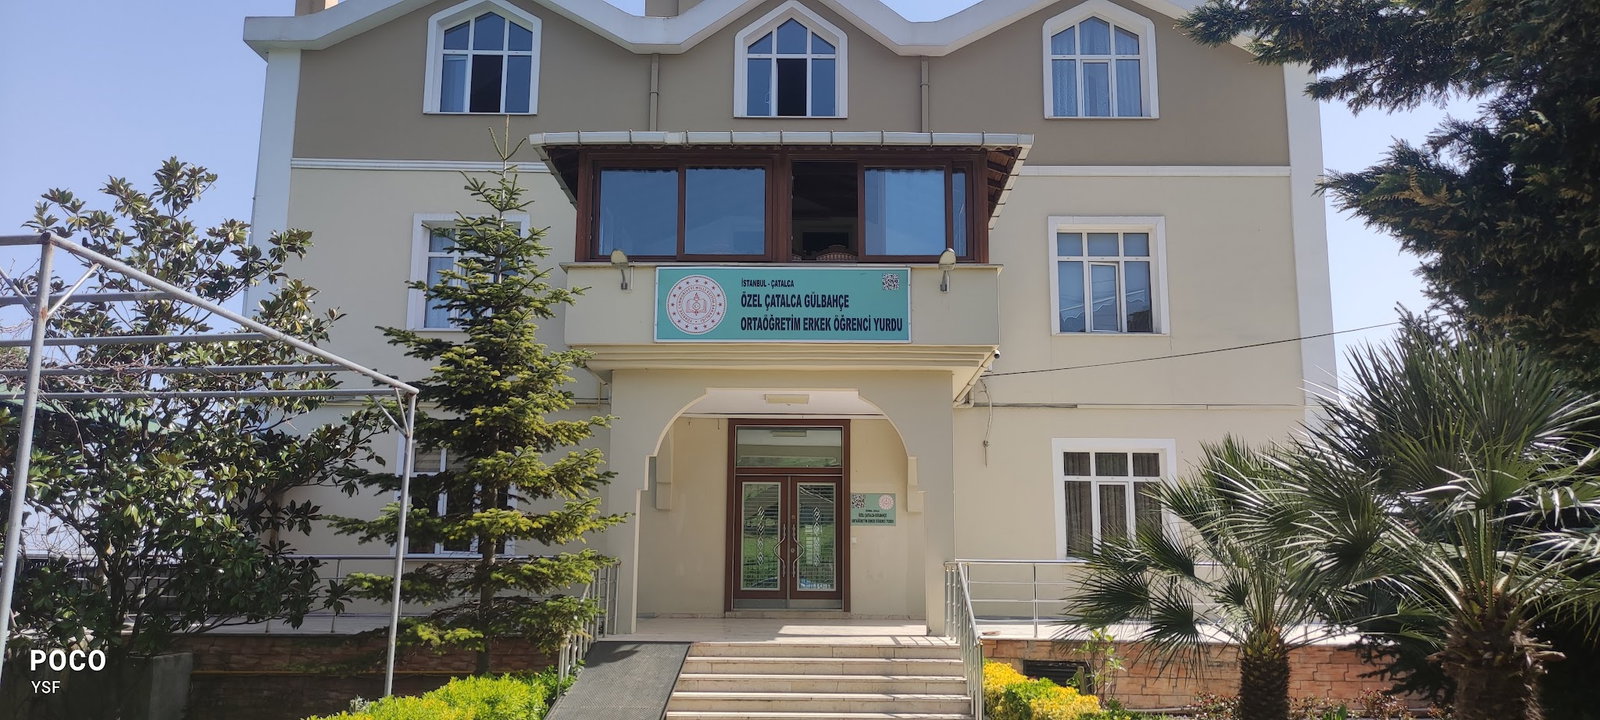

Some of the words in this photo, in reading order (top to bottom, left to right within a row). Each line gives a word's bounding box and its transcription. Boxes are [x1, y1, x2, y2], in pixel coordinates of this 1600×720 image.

[741, 277, 767, 288] İSTANBUL
[771, 279, 795, 289] ÇATALCA
[741, 291, 762, 308] ÖZEL
[765, 294, 801, 311] ÇATALCA
[804, 291, 850, 312] GÜLBAHÇE
[740, 314, 801, 331] ORTAÖĞRETİM
[803, 317, 832, 331] ERKEK
[833, 314, 872, 332] ÖĞRENCİ
[873, 317, 903, 332] YURDU
